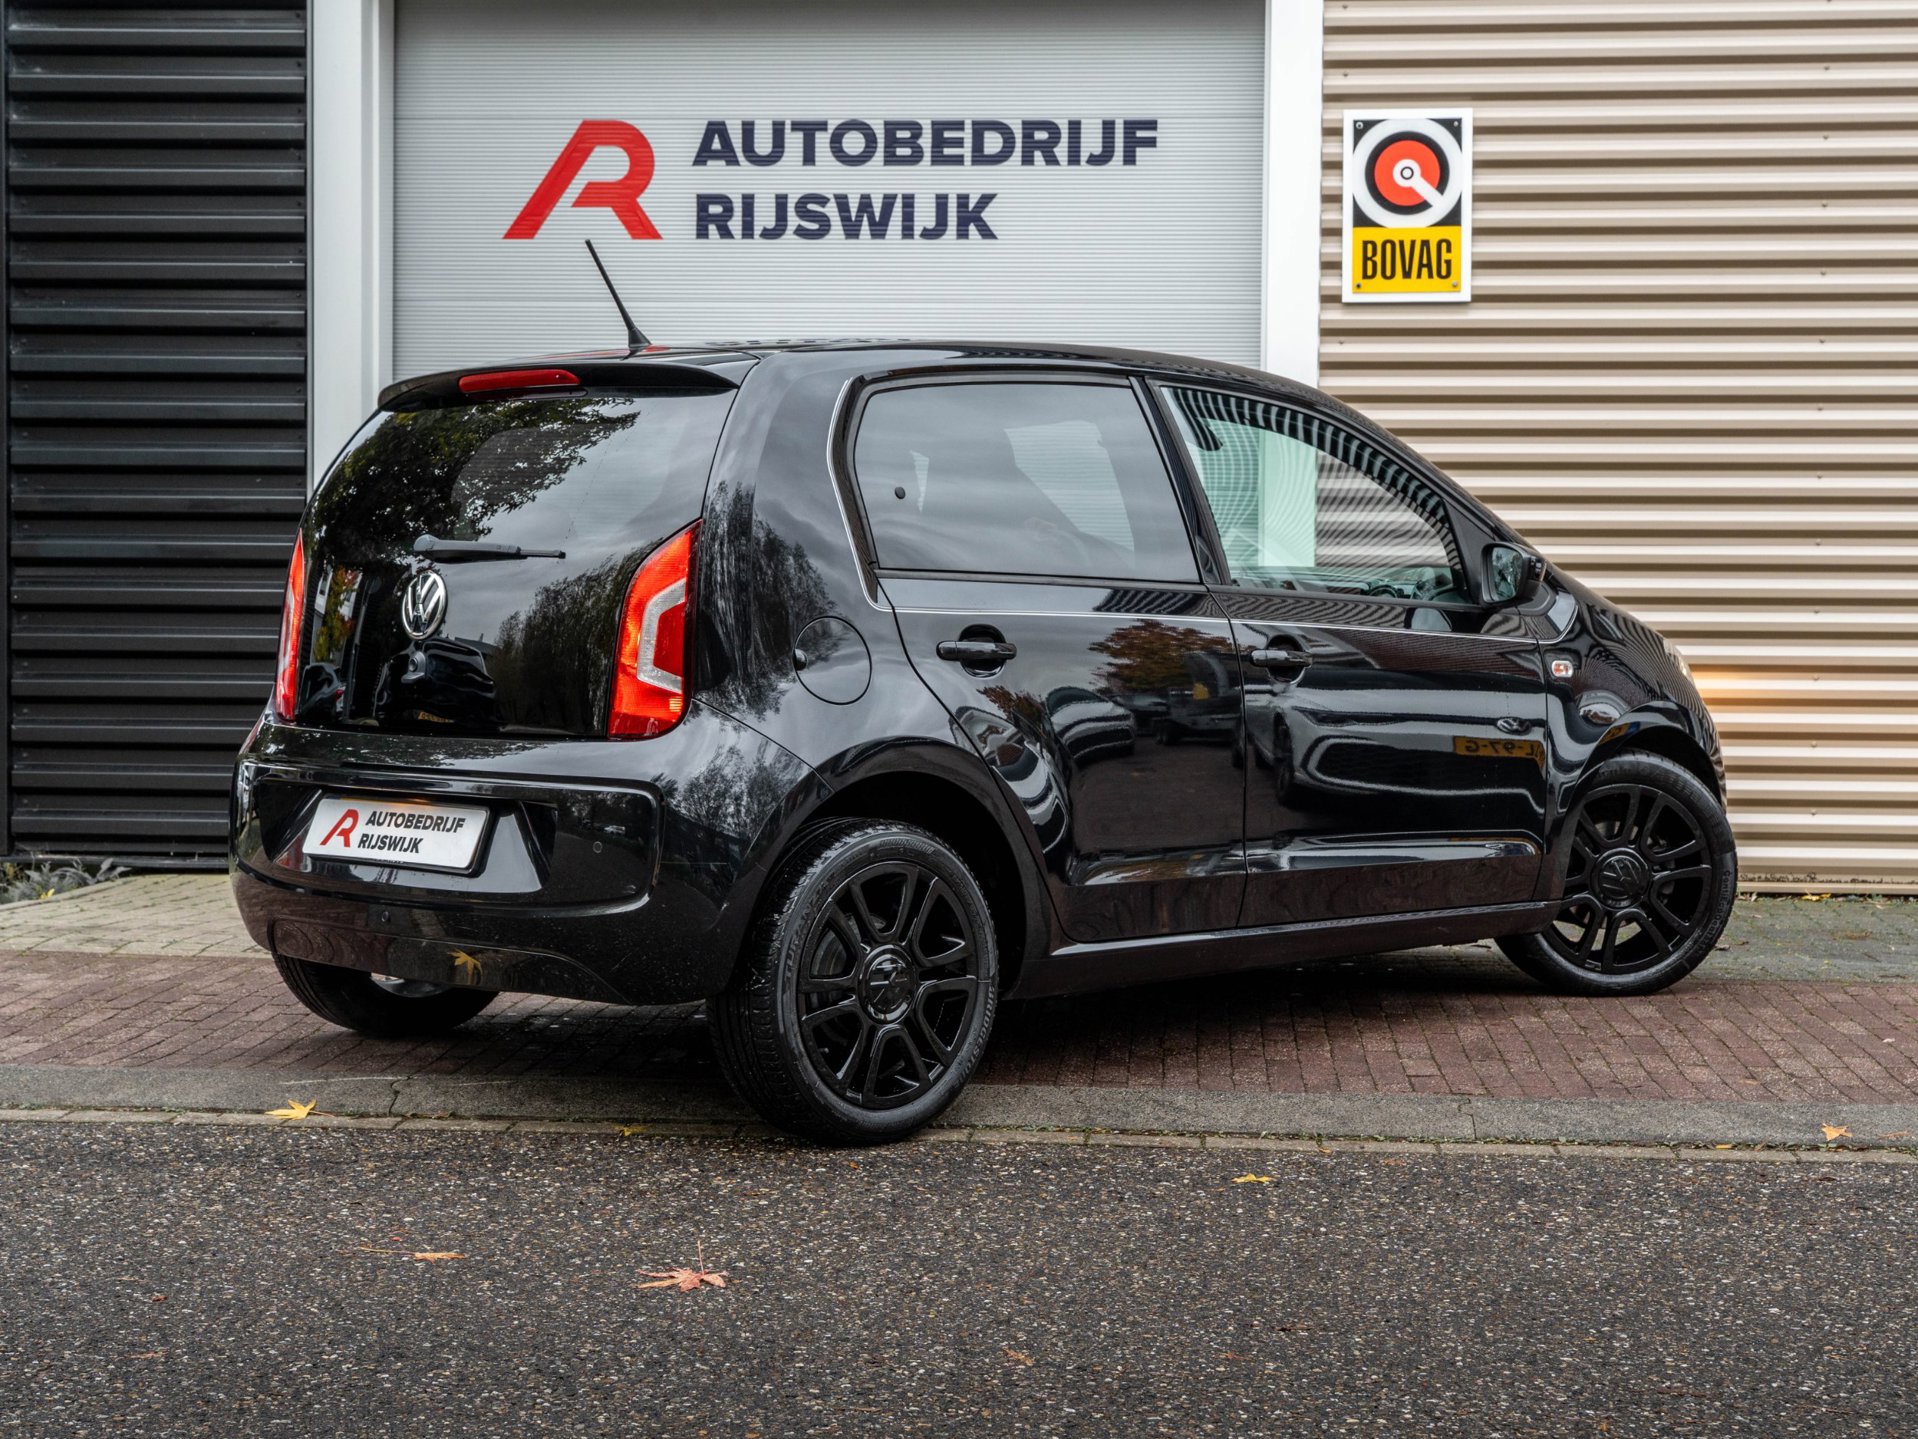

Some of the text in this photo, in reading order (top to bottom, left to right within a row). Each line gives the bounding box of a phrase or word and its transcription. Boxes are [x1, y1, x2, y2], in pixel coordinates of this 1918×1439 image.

[692, 119, 1158, 167] AUTOBEDRIJF
[695, 193, 998, 240] RIJSWIJK
[1361, 238, 1453, 281] BOVAG
[357, 833, 424, 854] RIJSWIJK
[365, 810, 466, 834] AUTOBEDRIJF
